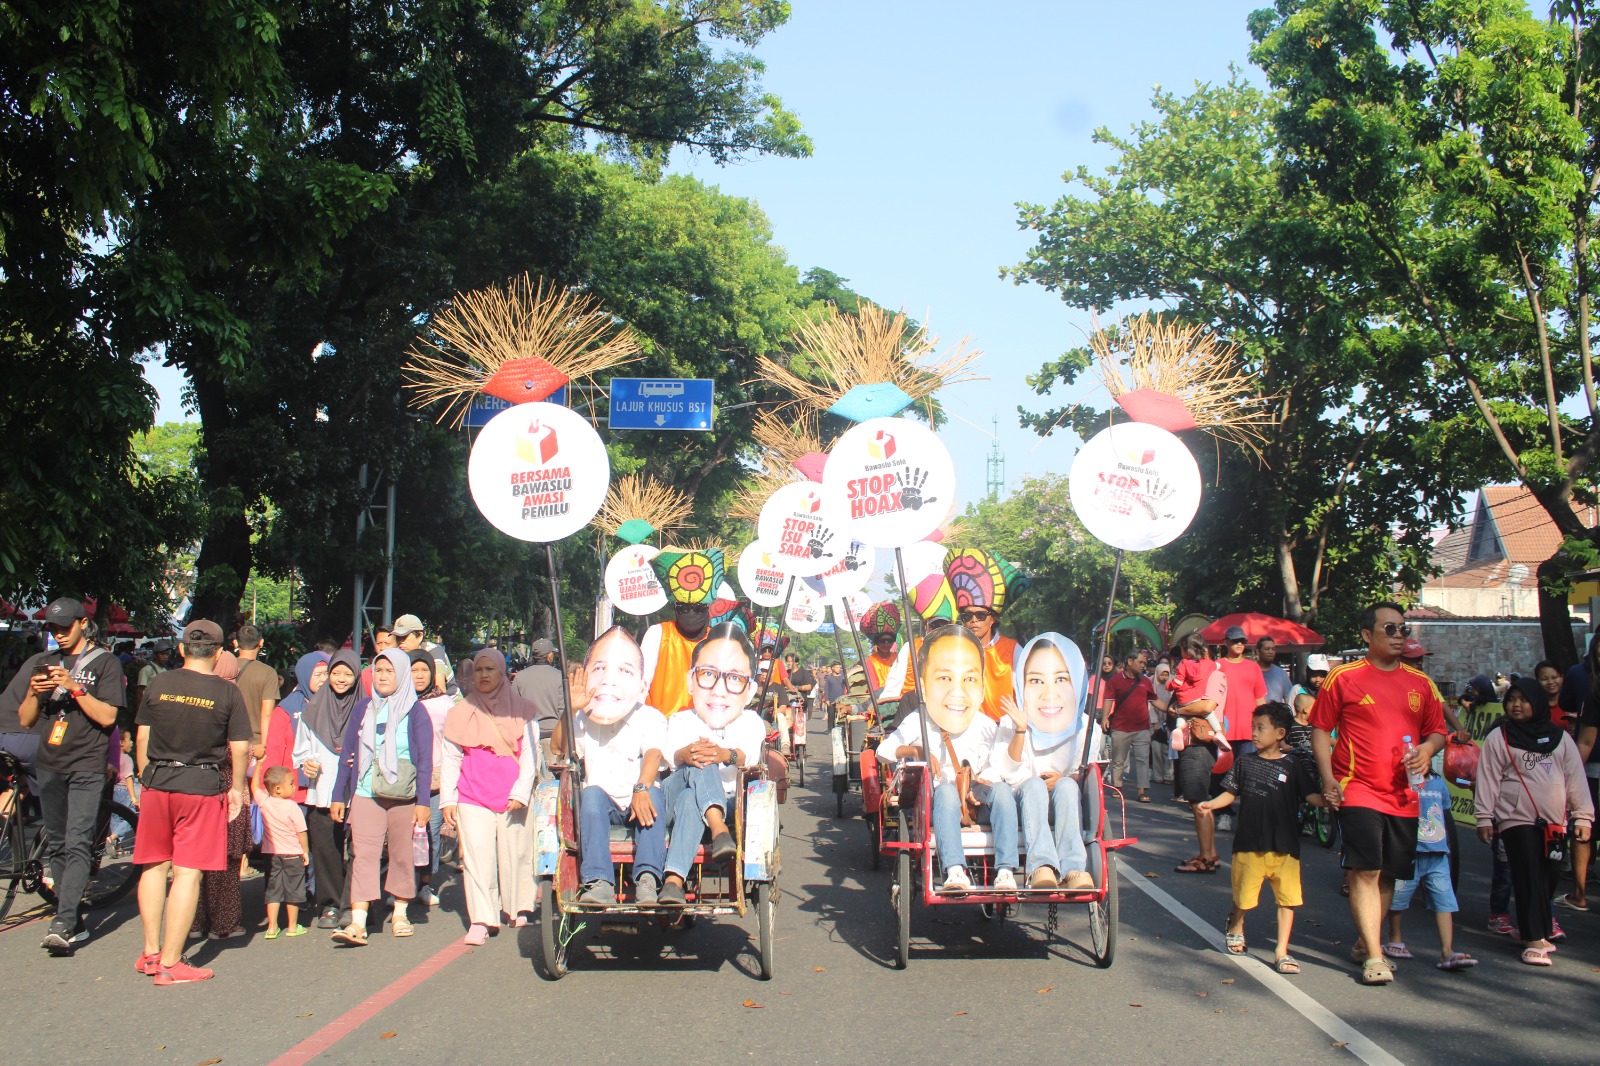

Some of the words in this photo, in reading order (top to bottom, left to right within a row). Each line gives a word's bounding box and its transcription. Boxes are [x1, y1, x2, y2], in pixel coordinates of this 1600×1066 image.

[616, 401, 645, 412] LAJUR
[648, 401, 684, 413] KHUSUS
[688, 402, 706, 413] BST
[864, 461, 892, 472] Bawaslu
[892, 458, 907, 467] Solo
[510, 466, 571, 485] BERSAMA
[1098, 471, 1140, 490] STOP
[512, 478, 573, 497] BAWASLU
[847, 473, 896, 500] STOP
[523, 491, 565, 508] AWASI
[851, 491, 904, 519] HOAX
[521, 502, 570, 520] PEMILU
[783, 517, 816, 534] STOP
[781, 530, 803, 544] ISU
[778, 542, 812, 560] SARA
[755, 568, 785, 578] BERSAMA
[755, 574, 784, 585] BAWASLU
[618, 575, 644, 587] STOP
[758, 581, 779, 590] AWASI
[619, 583, 647, 594] UJARAN
[620, 588, 659, 601] KEBENCIAN
[756, 586, 780, 596] PEMILU
